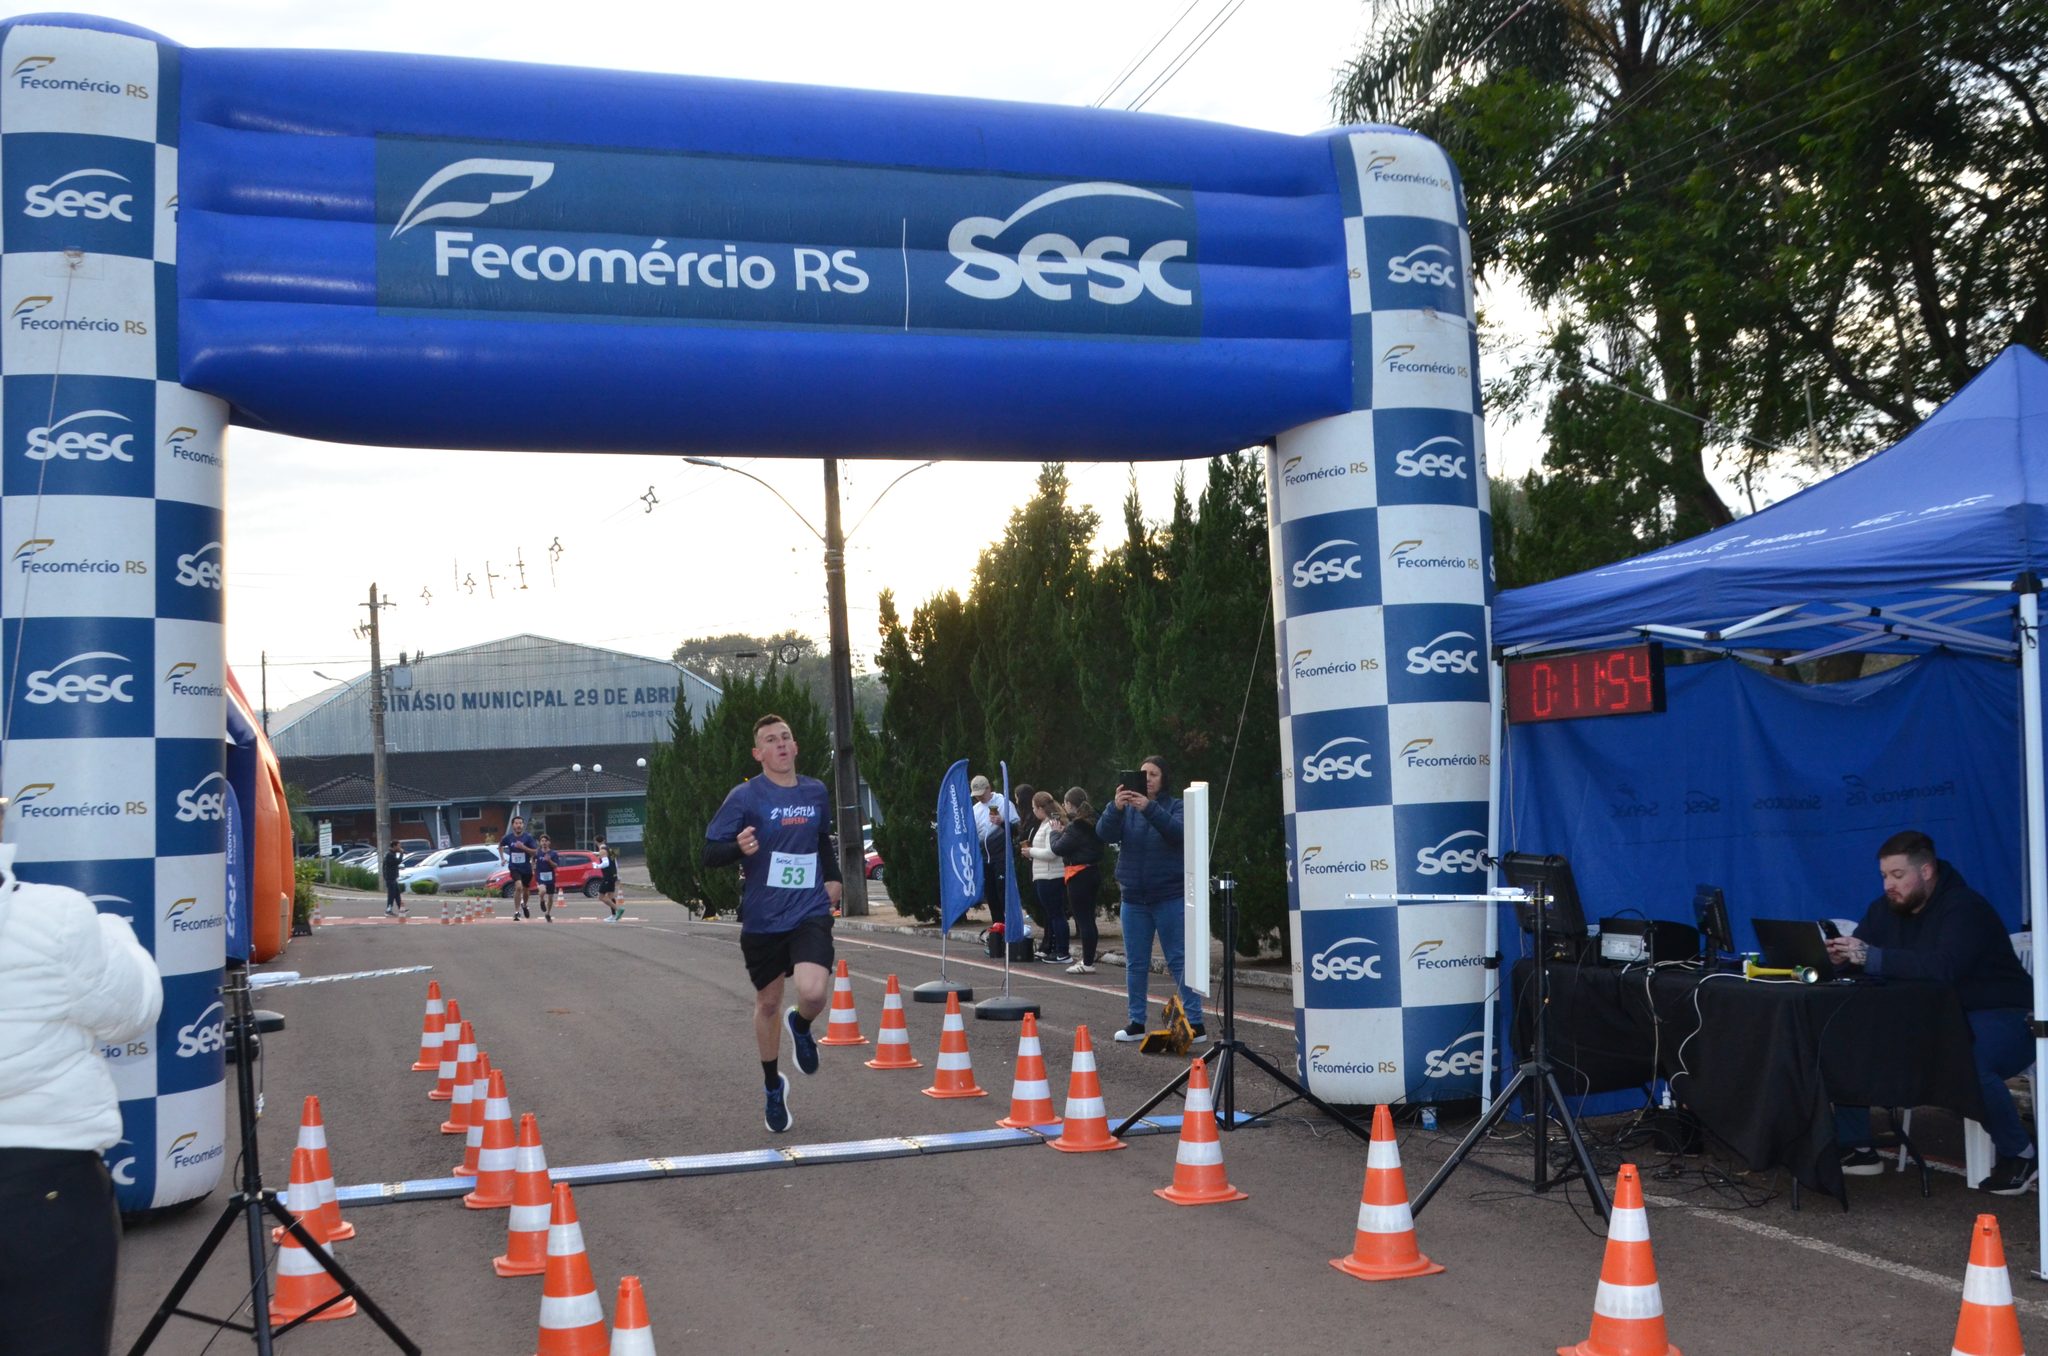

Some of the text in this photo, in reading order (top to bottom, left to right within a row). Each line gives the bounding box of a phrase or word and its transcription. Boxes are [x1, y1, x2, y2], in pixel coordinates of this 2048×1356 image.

[20, 76, 150, 100] Fecomércio RS
[1374, 171, 1439, 187] Fecomércio
[23, 184, 134, 223] Sesc
[434, 230, 870, 295] Fecomércio RS
[945, 216, 1193, 306] Sesc
[1387, 255, 1456, 289] Sesc
[20, 316, 148, 336] Fecomércio RS
[1389, 361, 1469, 379] Fecomércio RS
[24, 426, 134, 463] Sesc
[1285, 461, 1369, 487] Fecomércio RS
[1395, 449, 1467, 479] Sesc
[21, 559, 148, 575] Fecomércio RS
[1292, 554, 1362, 588] Sesc
[1397, 556, 1466, 569] Fecomércio
[1467, 558, 1480, 570] RS
[1295, 658, 1379, 679] Fecomércio RS
[1406, 645, 1479, 675] Sesc
[24, 670, 134, 705] Sesc
[1531, 652, 1653, 718] 0:11:54
[461, 689, 568, 711] MUNICIPAL
[574, 688, 599, 706] 29
[603, 687, 629, 706] DE
[1302, 753, 1373, 783] Sesc
[1407, 753, 1491, 769] Fecomércio RS
[21, 801, 148, 818] Fecomércio RS
[781, 867, 805, 886] 53
[959, 842, 976, 897] Sesc
[1304, 860, 1366, 875] Fecomércio
[1370, 859, 1389, 872] RS
[1311, 953, 1382, 981] Sesc
[126, 1043, 149, 1057] RS
[1313, 1061, 1374, 1075] Fecomércio
[1378, 1061, 1397, 1074] RS
